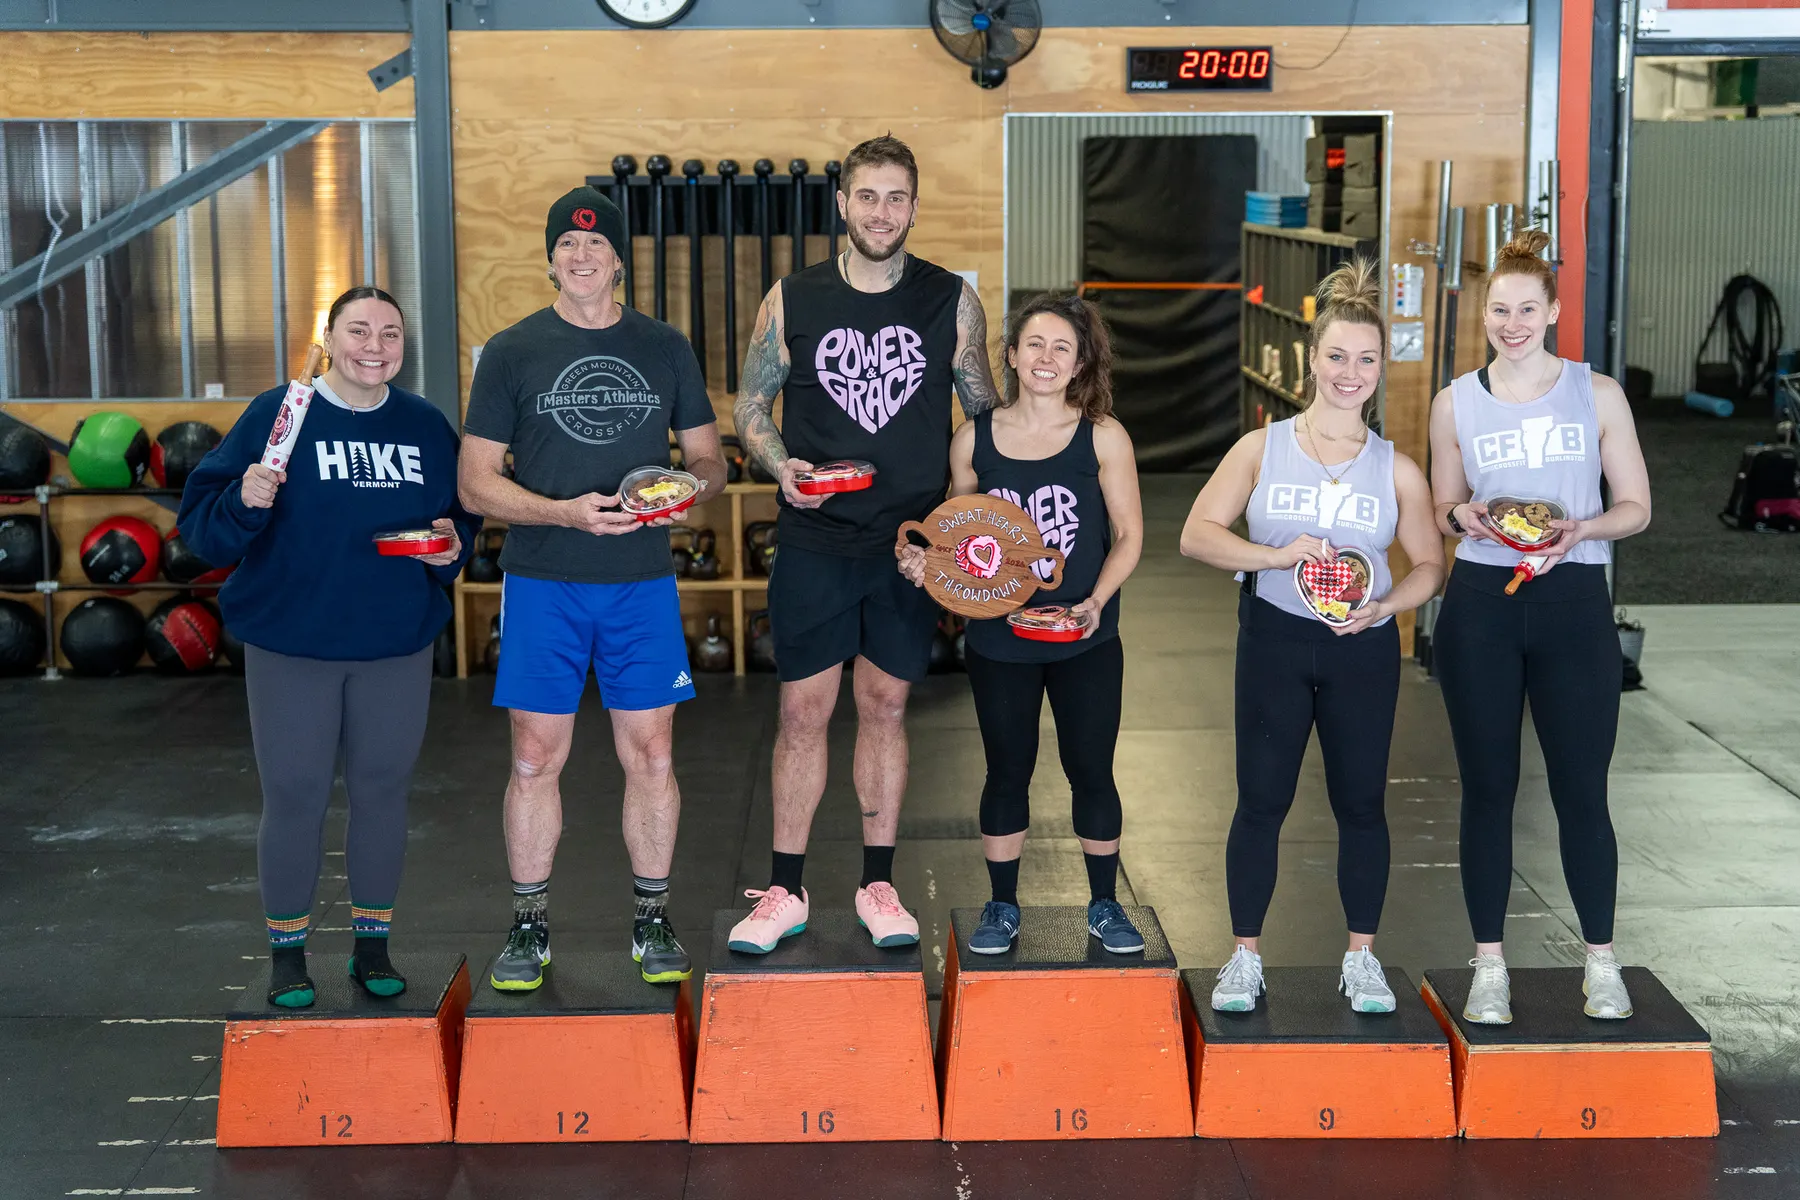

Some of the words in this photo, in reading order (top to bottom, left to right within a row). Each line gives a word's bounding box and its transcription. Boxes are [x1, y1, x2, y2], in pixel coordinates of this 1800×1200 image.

[1179, 51, 1269, 78] 20:00
[1131, 81, 1168, 89] ROGUE
[815, 325, 926, 379] POWER
[561, 365, 588, 390] GREEN
[590, 361, 640, 387] MOUNTAIN
[866, 367, 877, 379] &
[544, 393, 598, 408] Masters
[603, 390, 661, 404] Athletics
[817, 361, 927, 434] GRACE
[565, 411, 637, 437] CROSSFIT
[315, 441, 424, 485] HIKE
[1493, 460, 1527, 470] CROSSFIT
[1545, 455, 1586, 463] BURLINGTON
[352, 480, 401, 489] VERMONT
[1283, 514, 1318, 523] CROSSFIT
[1335, 520, 1378, 535] BURLINGTON
[934, 570, 1022, 602] THROWDOWN
[319, 1114, 353, 1138] 12
[556, 1111, 590, 1135] 12
[801, 1110, 835, 1134] 16
[1054, 1108, 1088, 1132] 16
[1318, 1107, 1335, 1131] 9
[1580, 1107, 1597, 1131] 9
